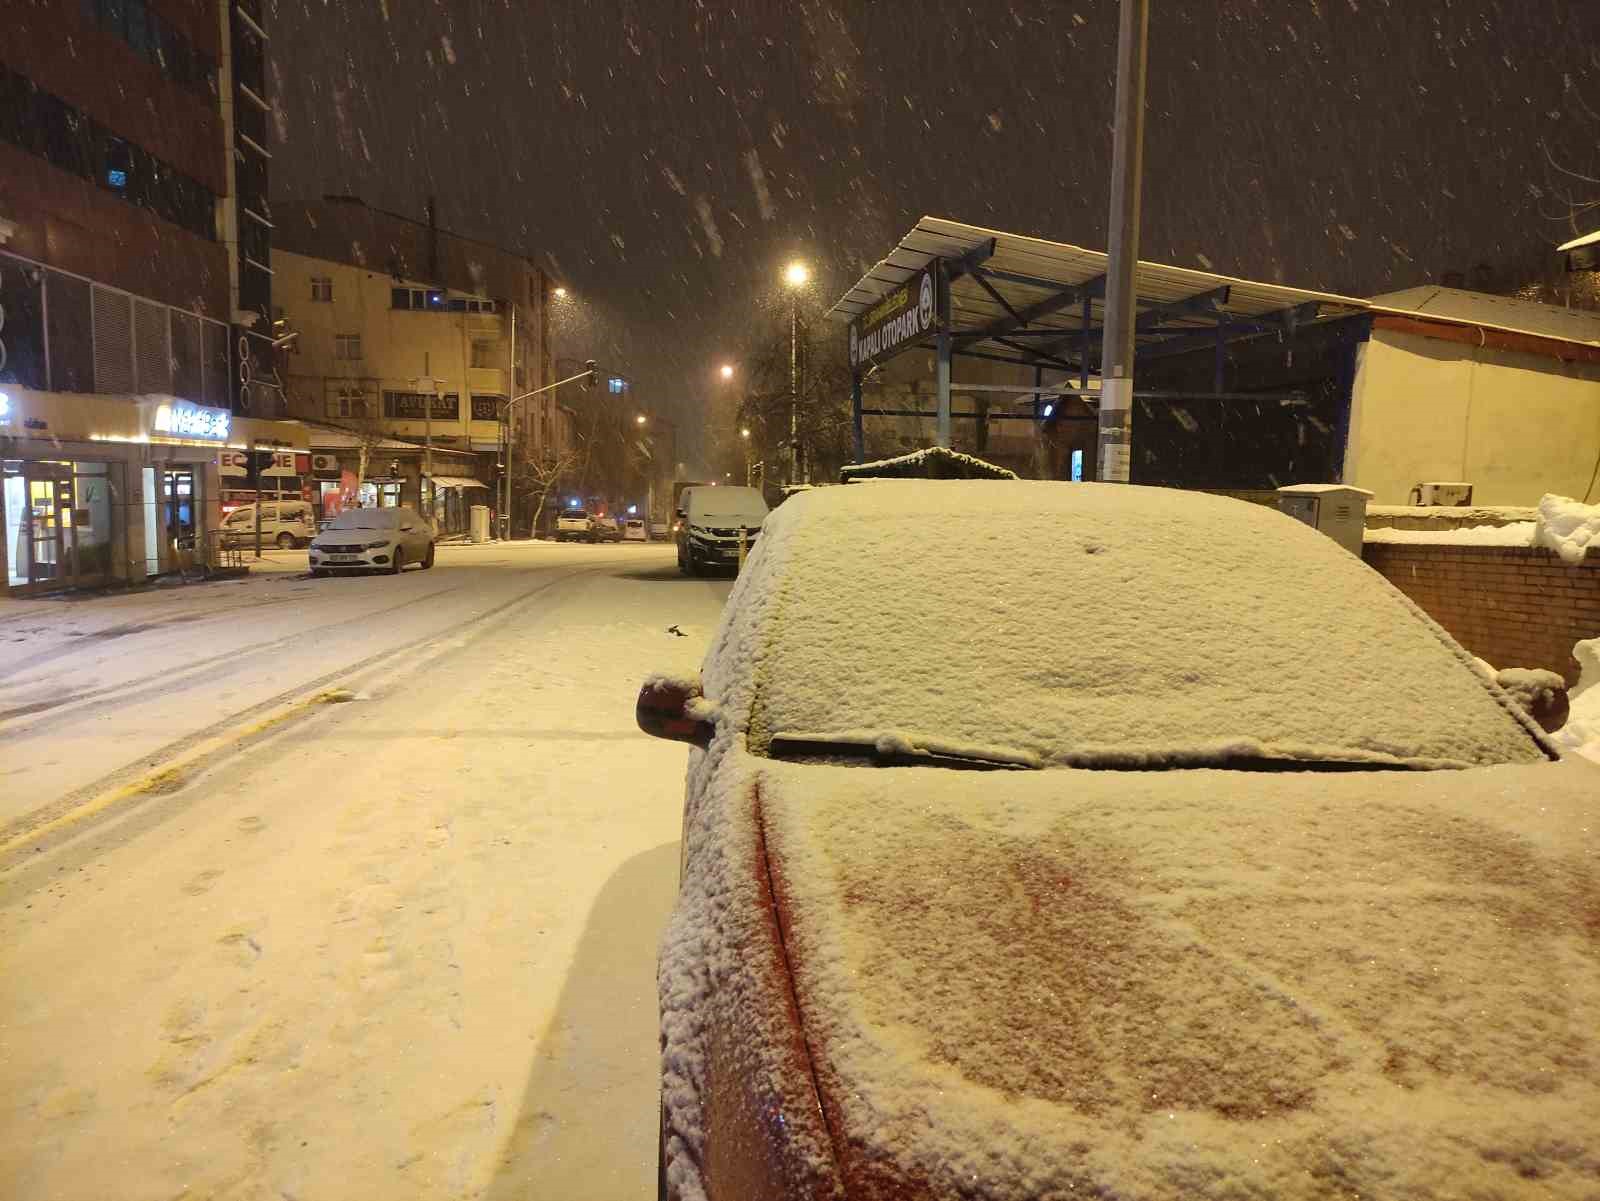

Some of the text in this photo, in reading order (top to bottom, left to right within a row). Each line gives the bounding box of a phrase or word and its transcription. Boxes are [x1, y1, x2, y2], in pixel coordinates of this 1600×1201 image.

[858, 330, 881, 363] KAPALI
[882, 305, 919, 350] OTOPARK
[221, 453, 292, 467] ECNE
